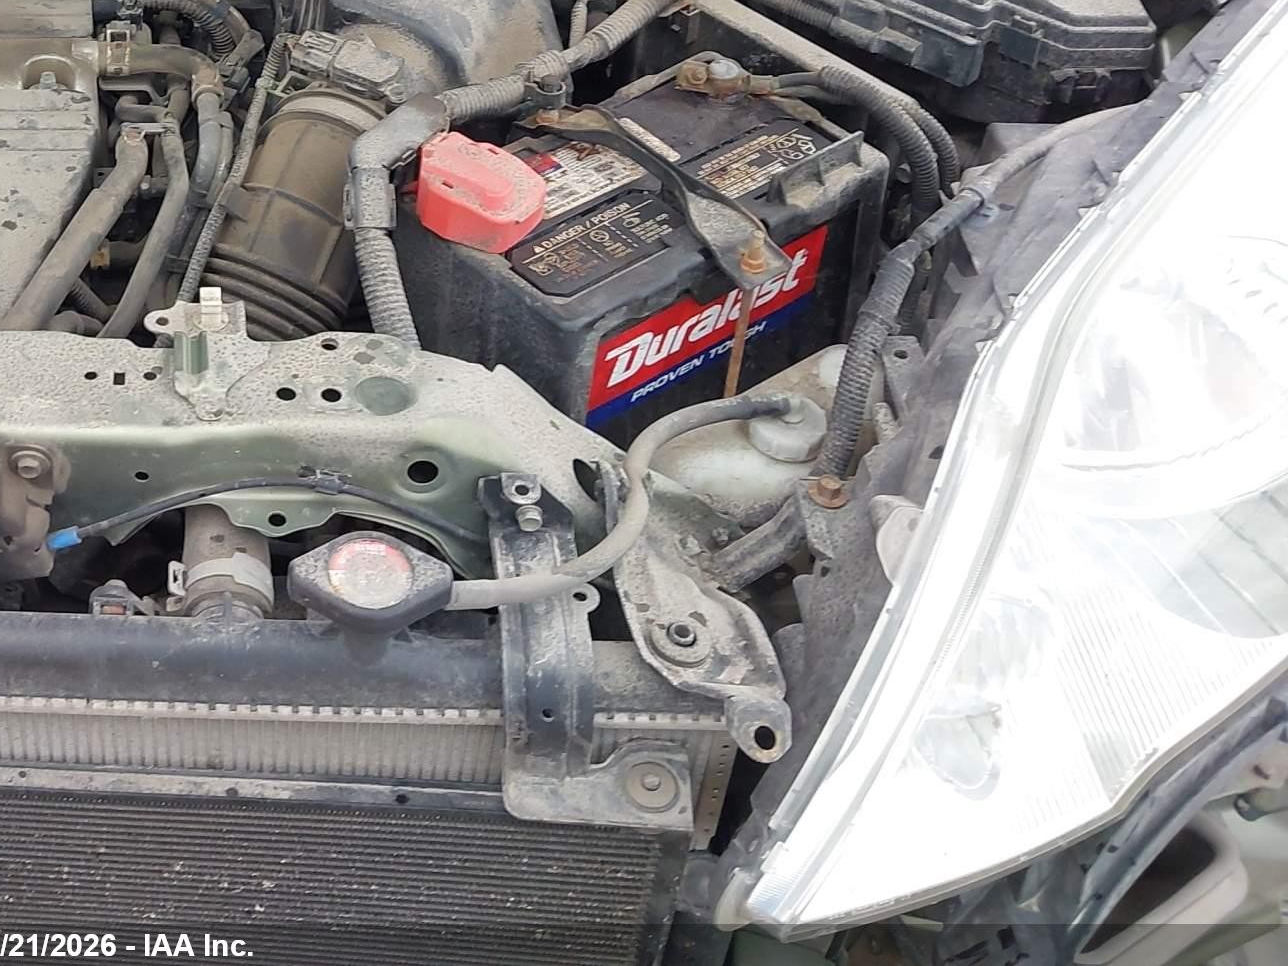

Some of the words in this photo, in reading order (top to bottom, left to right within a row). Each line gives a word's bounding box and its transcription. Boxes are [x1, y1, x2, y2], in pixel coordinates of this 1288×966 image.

[541, 224, 586, 250] DANGER
[592, 202, 631, 225] POISON
[605, 248, 809, 388] Duralast
[630, 353, 705, 403] PROVEN
[708, 320, 767, 360] TOGH
